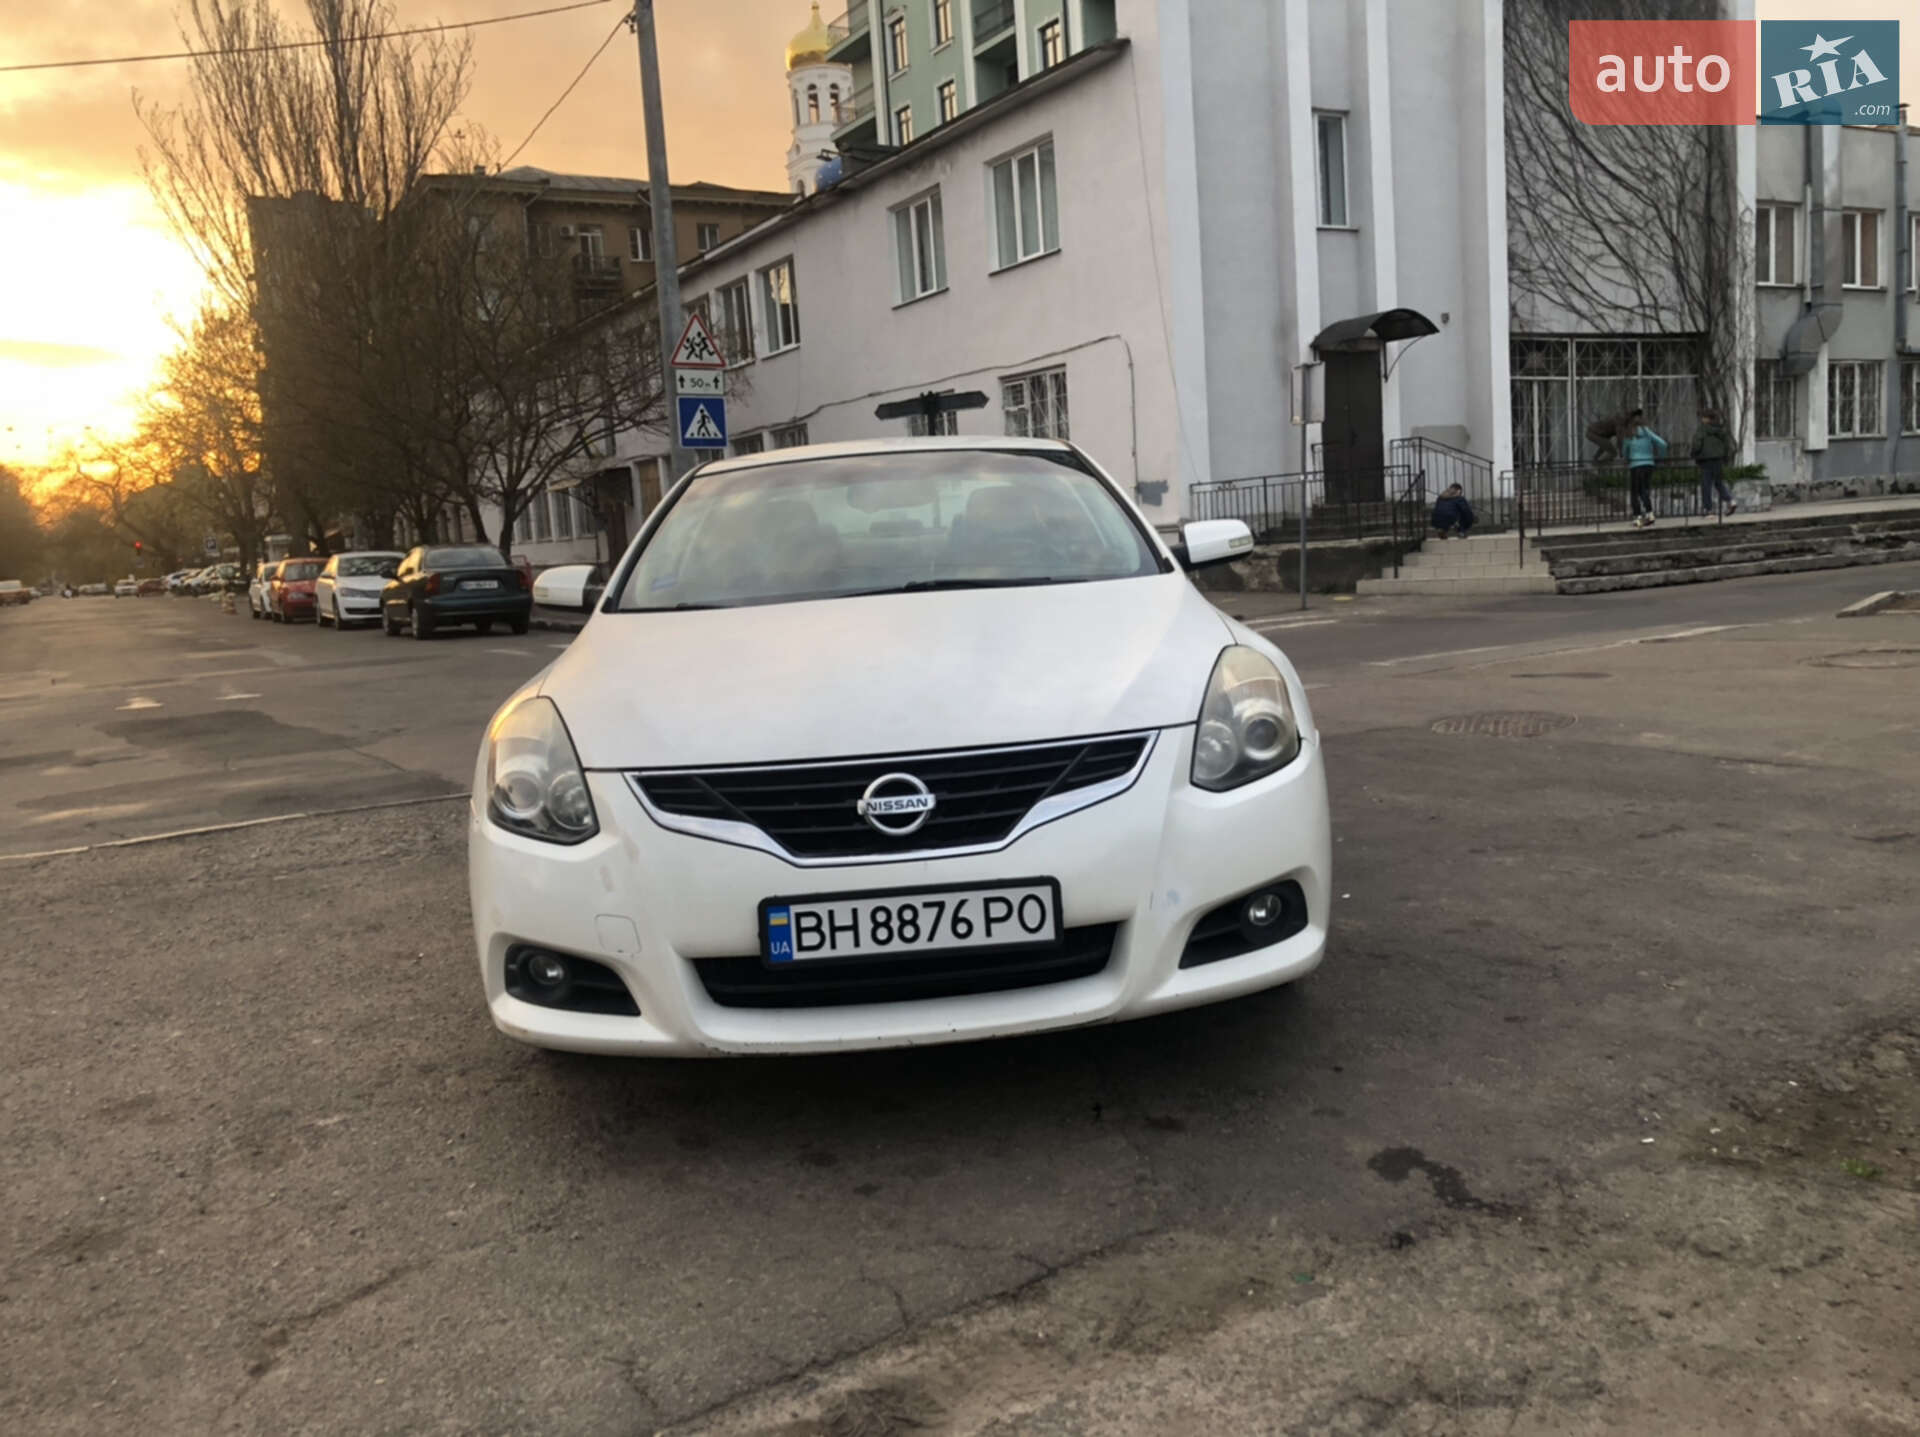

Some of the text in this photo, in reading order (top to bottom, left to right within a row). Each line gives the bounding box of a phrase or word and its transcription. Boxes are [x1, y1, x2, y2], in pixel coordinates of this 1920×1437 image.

[866, 798, 928, 812] NISSAN
[795, 907, 861, 952] BH
[870, 899, 974, 946] 8876
[770, 941, 790, 954] UA
